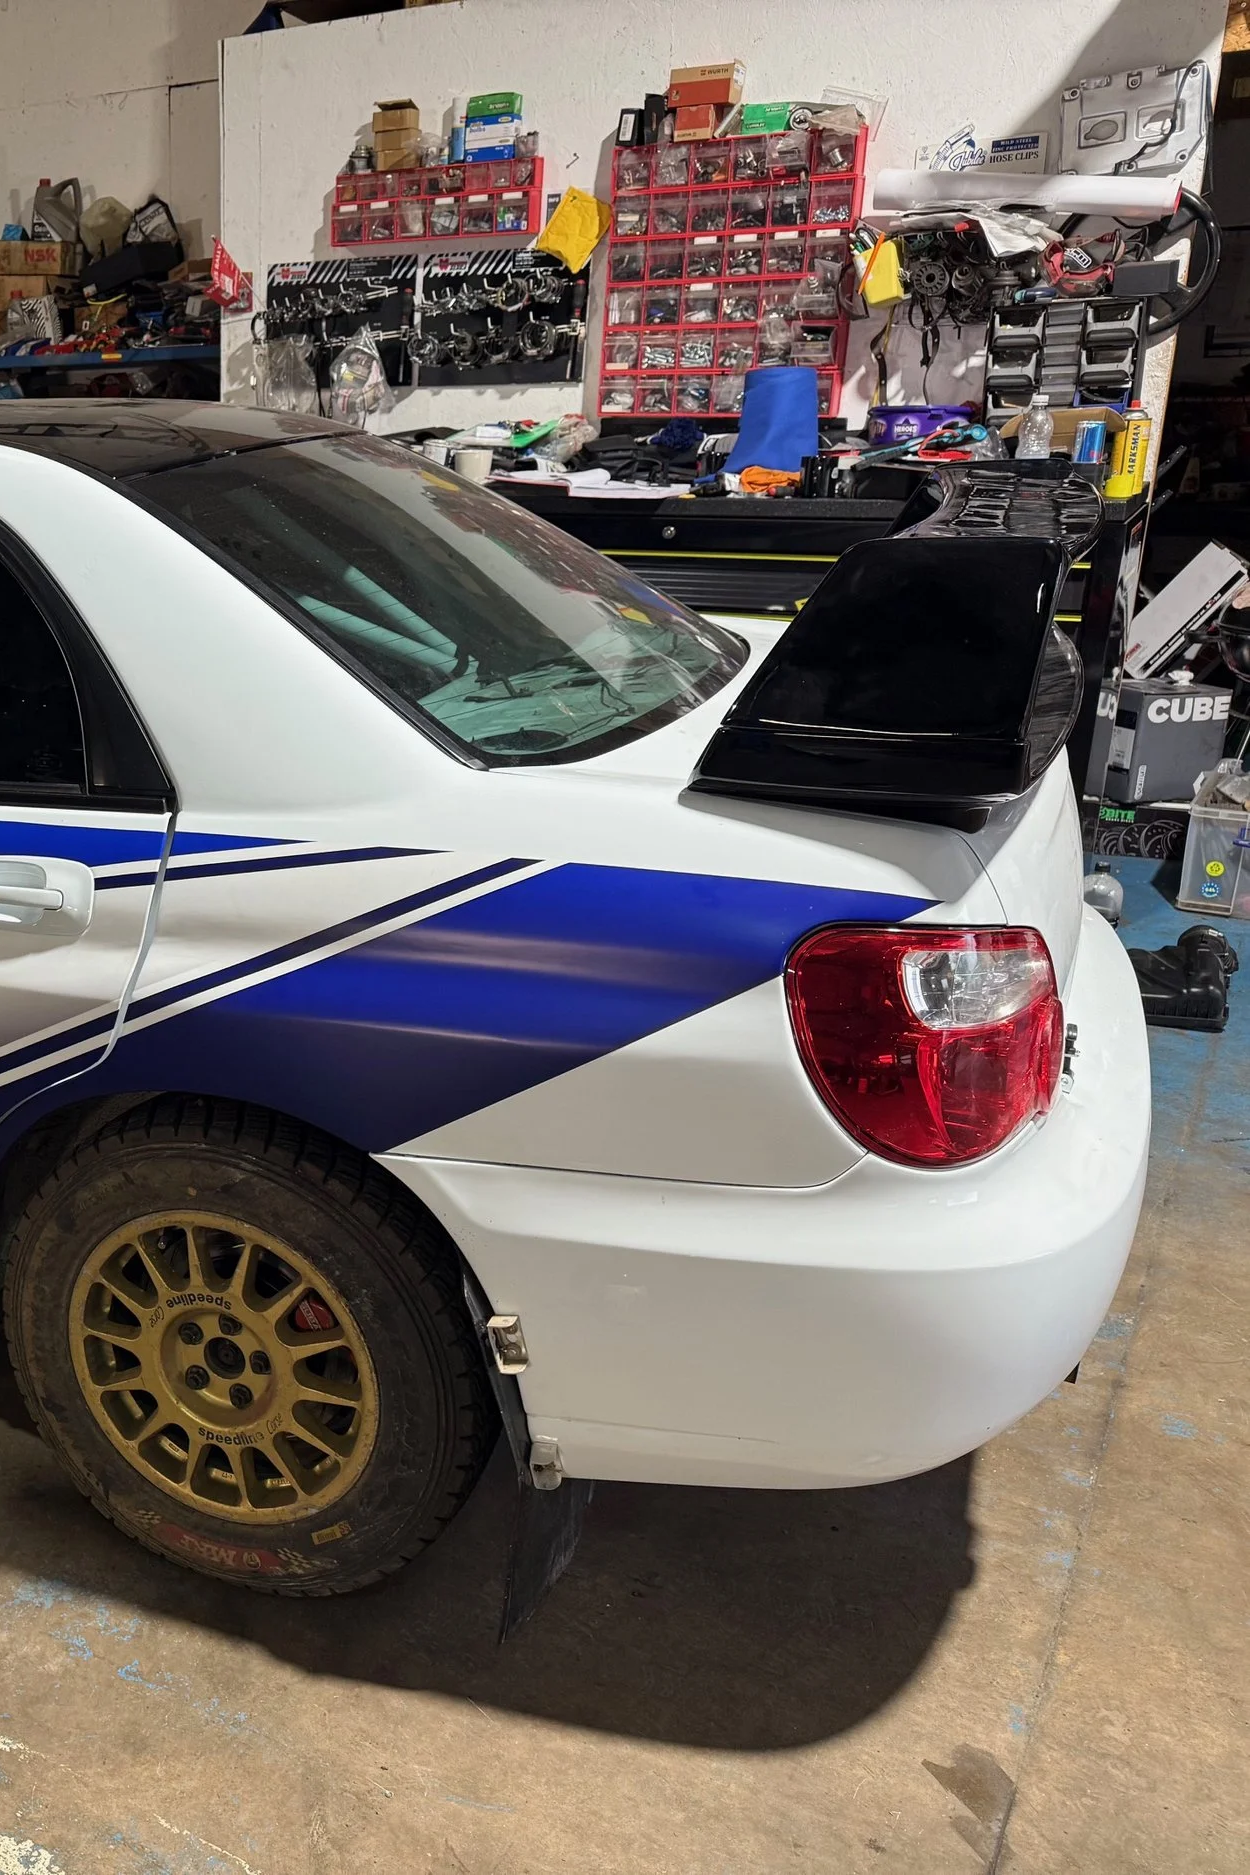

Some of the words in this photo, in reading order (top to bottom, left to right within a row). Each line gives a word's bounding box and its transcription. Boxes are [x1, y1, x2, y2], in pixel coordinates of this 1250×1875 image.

[989, 154, 1013, 164] HOSE
[1014, 151, 1039, 161] CLIPS
[24, 249, 58, 263] NSK
[894, 425, 918, 433] HEROES
[1147, 695, 1232, 724] CUBE
[165, 1293, 232, 1310] speedline
[198, 1427, 266, 1446] speedline
